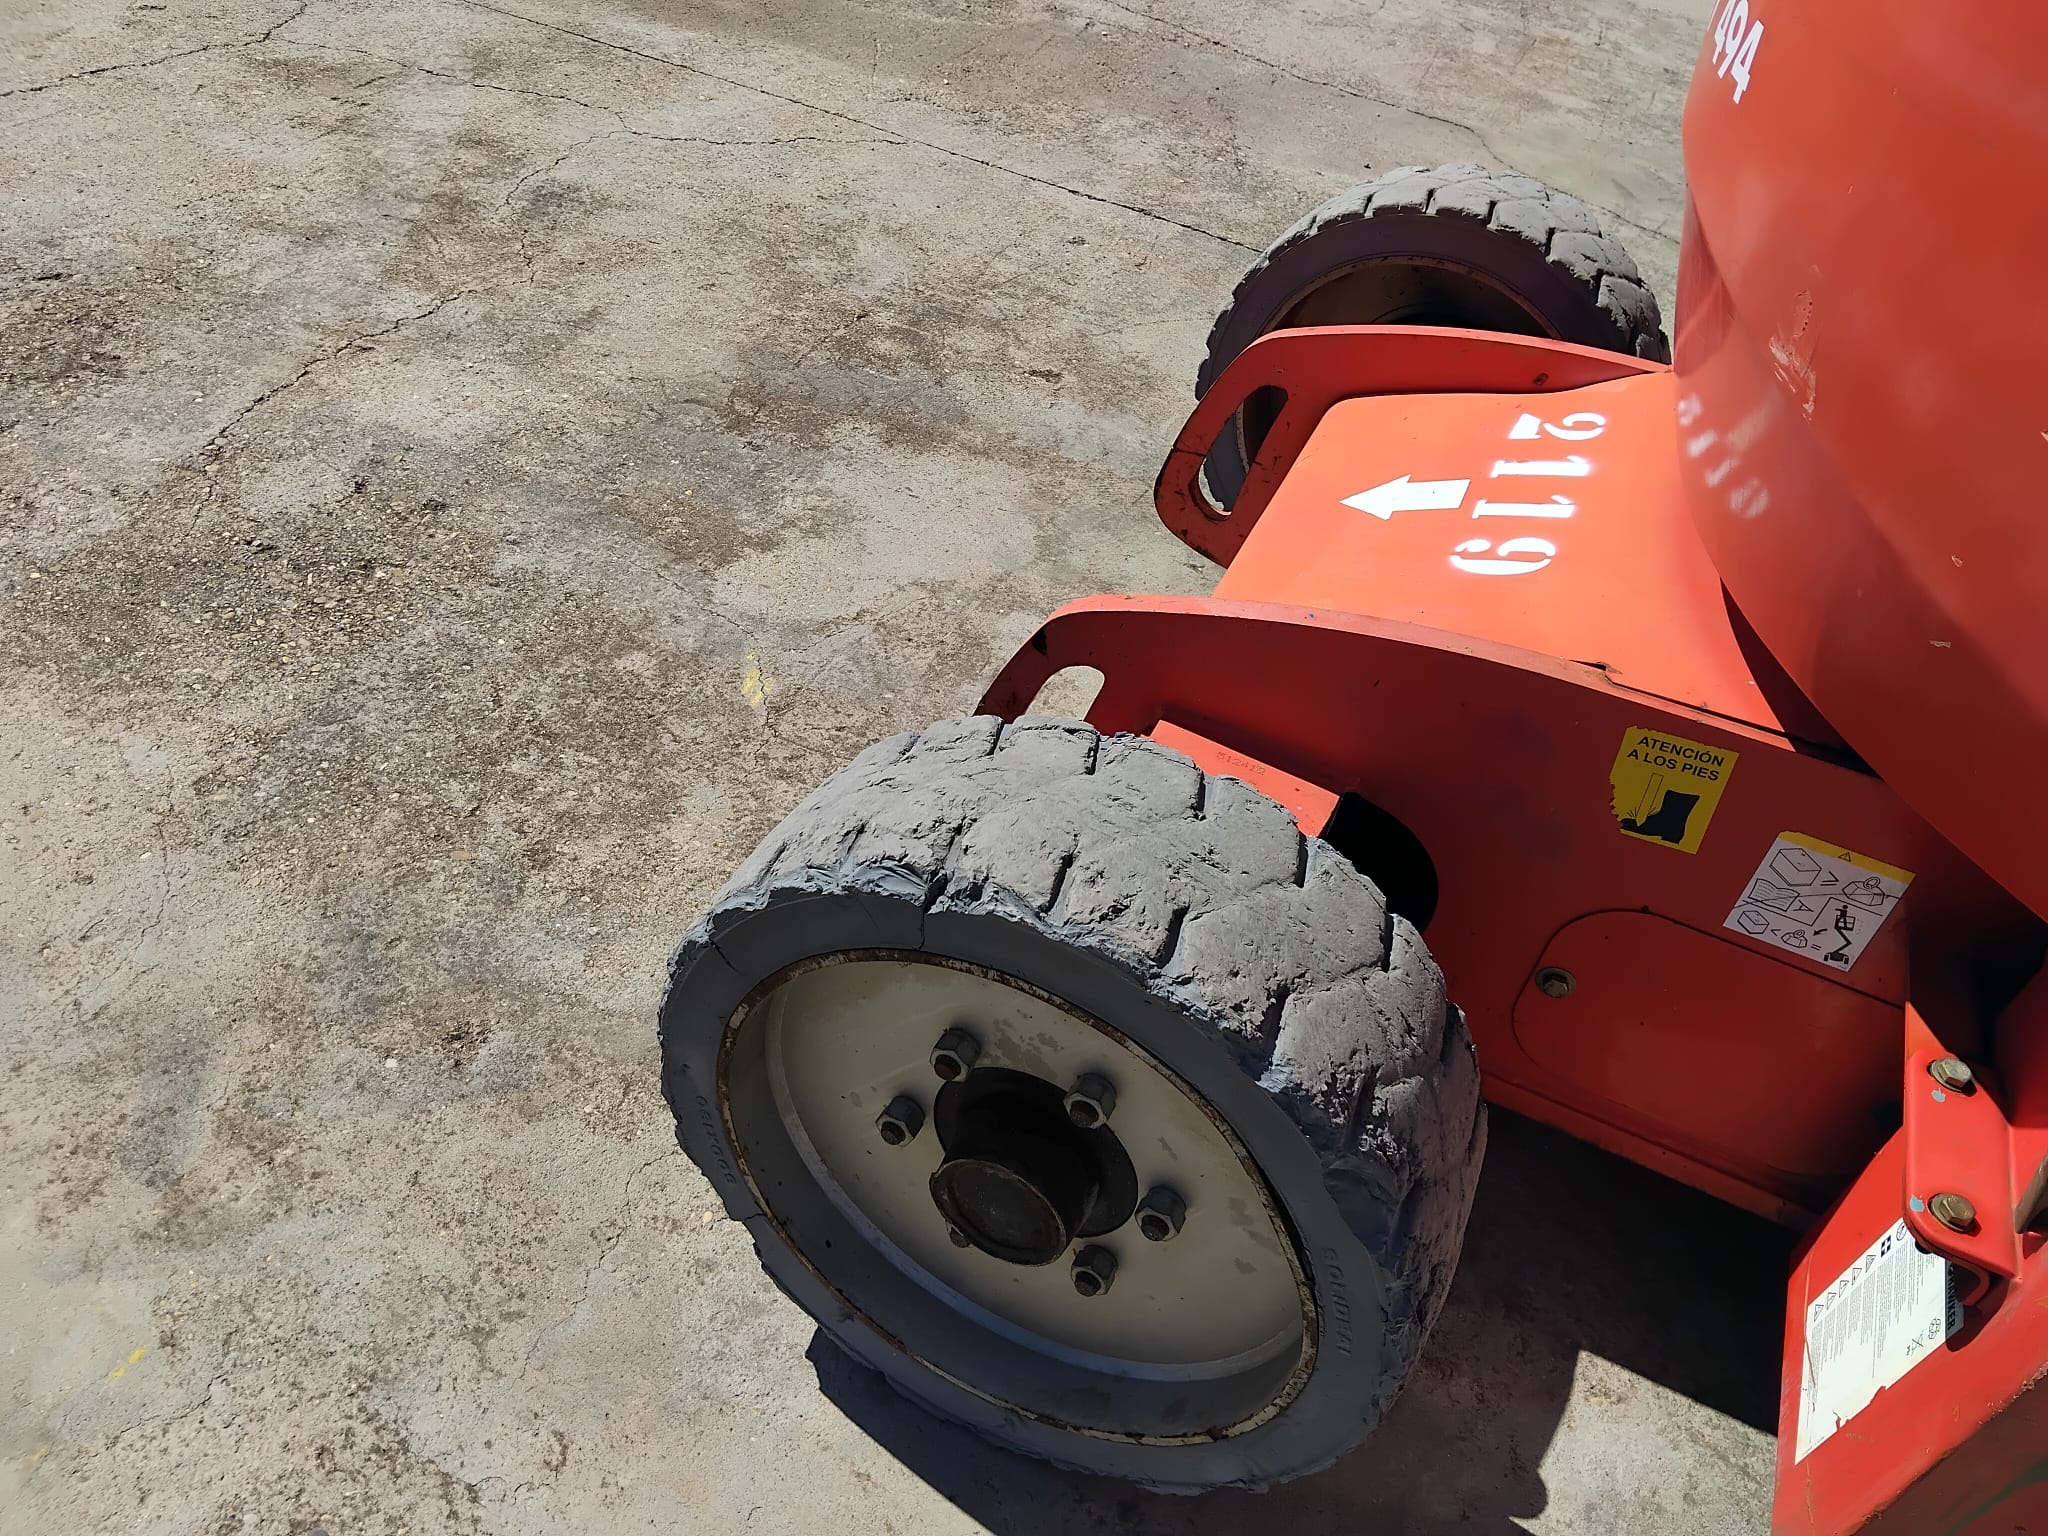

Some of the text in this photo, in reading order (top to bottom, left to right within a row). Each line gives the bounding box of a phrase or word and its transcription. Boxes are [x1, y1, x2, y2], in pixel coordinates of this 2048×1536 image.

[1449, 411, 1607, 576] 2119
[1627, 749, 1720, 781] A LOS PIES
[1638, 736, 1725, 767] ATENCIÓN
